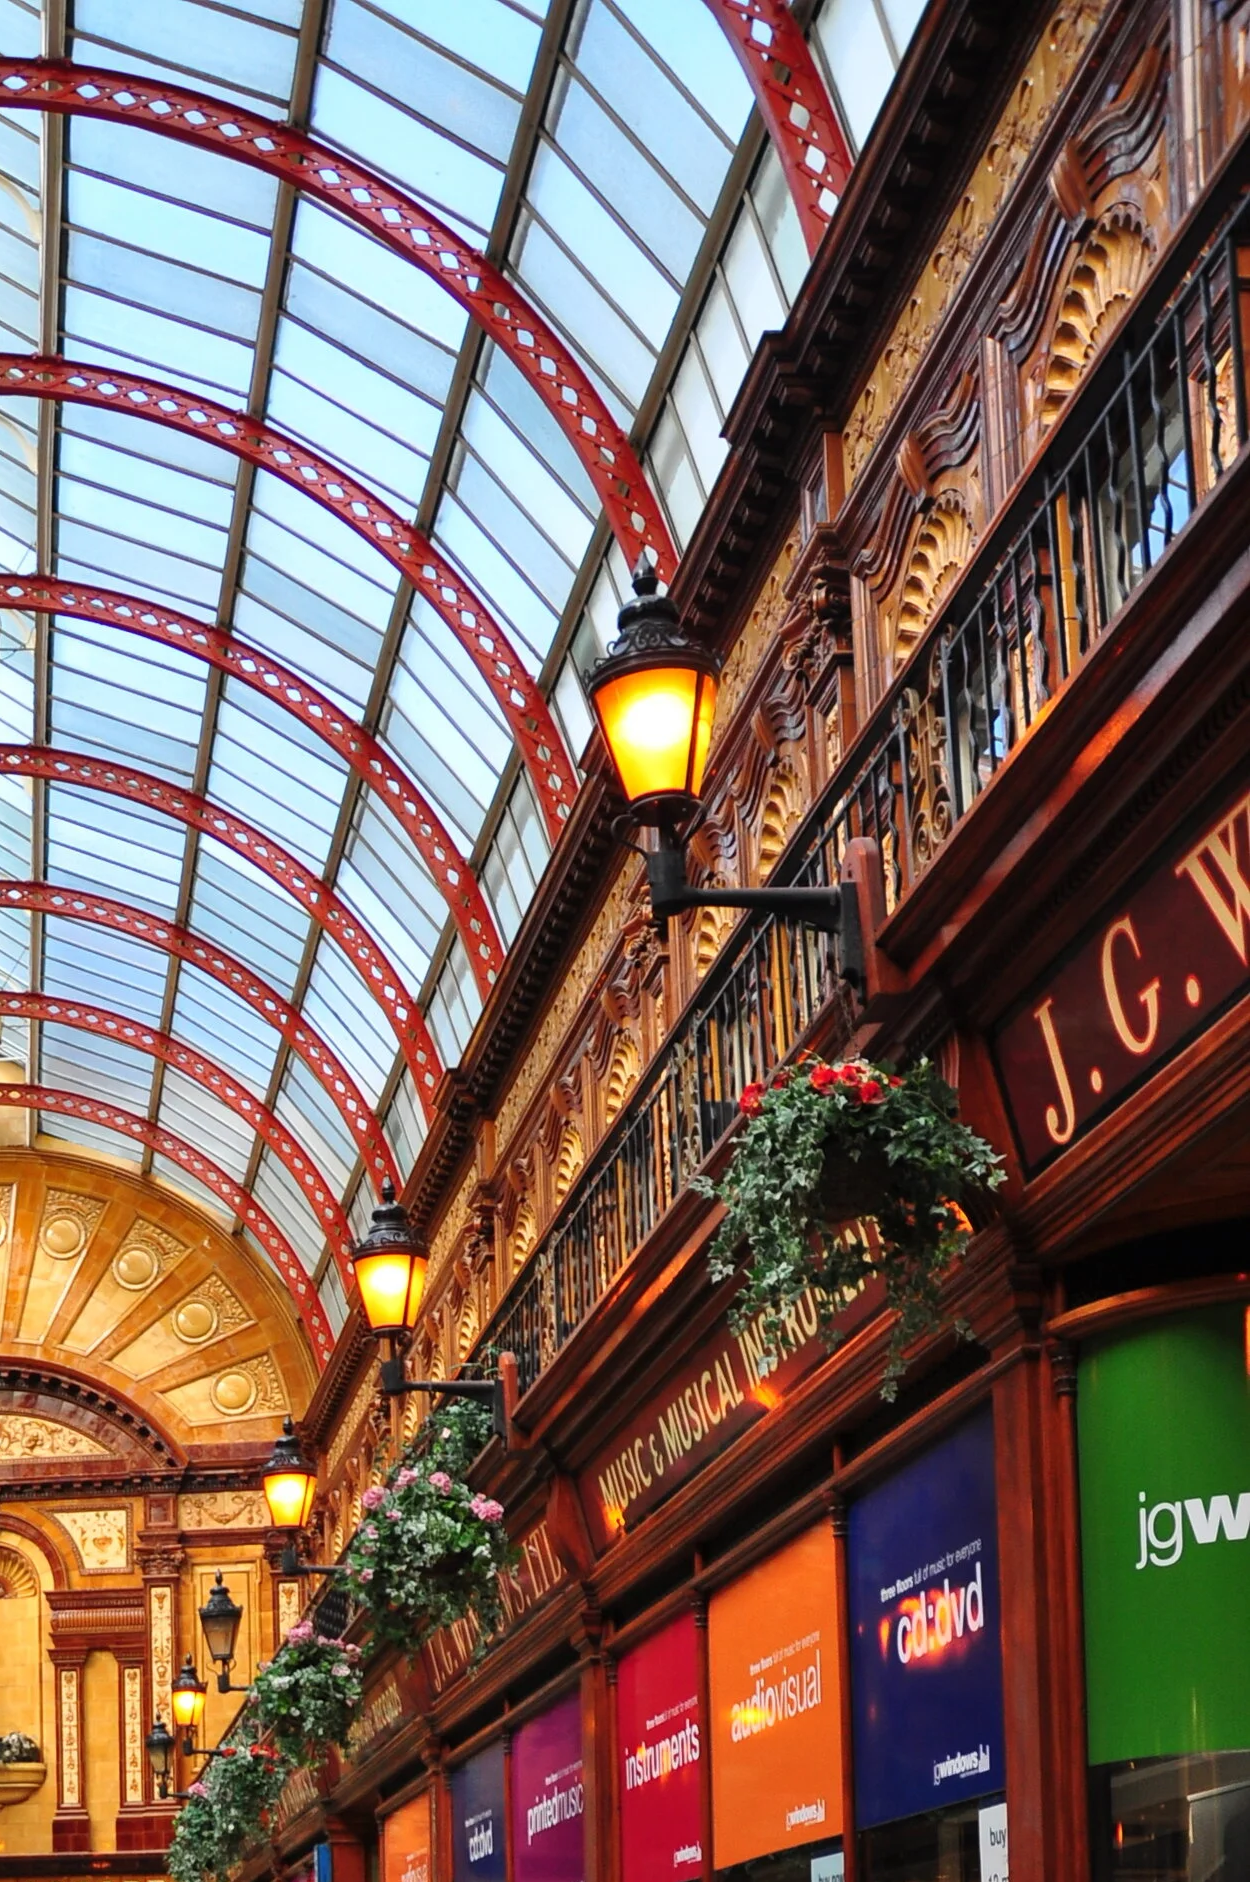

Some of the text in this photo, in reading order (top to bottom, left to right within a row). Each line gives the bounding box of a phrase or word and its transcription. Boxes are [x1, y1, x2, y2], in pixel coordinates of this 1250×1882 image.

[598, 1437, 652, 1510] MUSIC
[649, 1432, 664, 1476] &
[658, 1351, 745, 1466] MUSICAL
[880, 1586, 897, 1603] three
[895, 1576, 914, 1595] floors
[897, 1561, 984, 1664] cd:dvd
[730, 1649, 822, 1743] audiovisual
[625, 1718, 700, 1790] instruments
[527, 1775, 584, 1846] printedmusic
